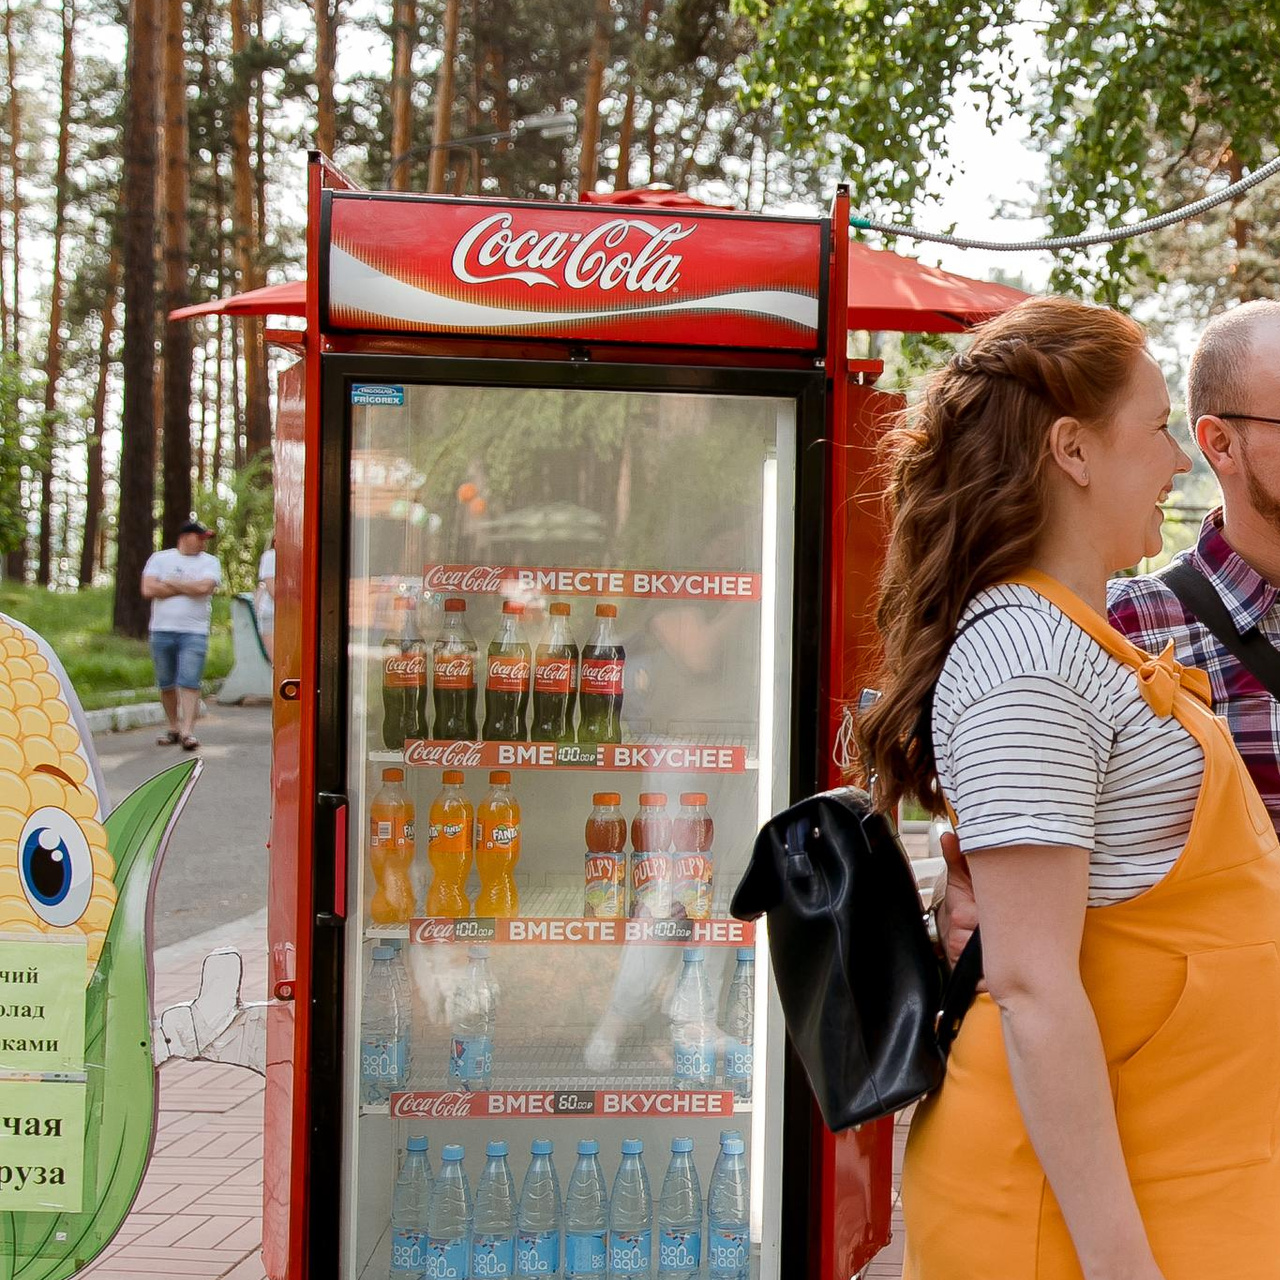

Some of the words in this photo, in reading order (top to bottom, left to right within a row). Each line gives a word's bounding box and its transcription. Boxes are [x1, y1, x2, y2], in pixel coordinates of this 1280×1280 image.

[452, 212, 697, 292] Coca-Cola
[424, 565, 504, 592] Coca-Cola
[517, 569, 624, 593] ВМЕСТЕ
[633, 573, 752, 596] ВКУСНЕЕ
[404, 740, 486, 766] Coca-Cola
[614, 747, 733, 768] ВКУСНЕЕ
[492, 824, 518, 841] FANTA
[585, 859, 613, 880] ULPY
[633, 858, 667, 887] PULPY
[676, 858, 704, 879] ULPY
[509, 921, 615, 940] ВМЕСТЕ
[394, 1092, 476, 1117] Coca-Cola
[603, 1094, 722, 1113] ВКУСНЕЕ
[614, 1247, 641, 1260] bon
[717, 1246, 745, 1258] bon
[614, 1258, 648, 1271] aqua
